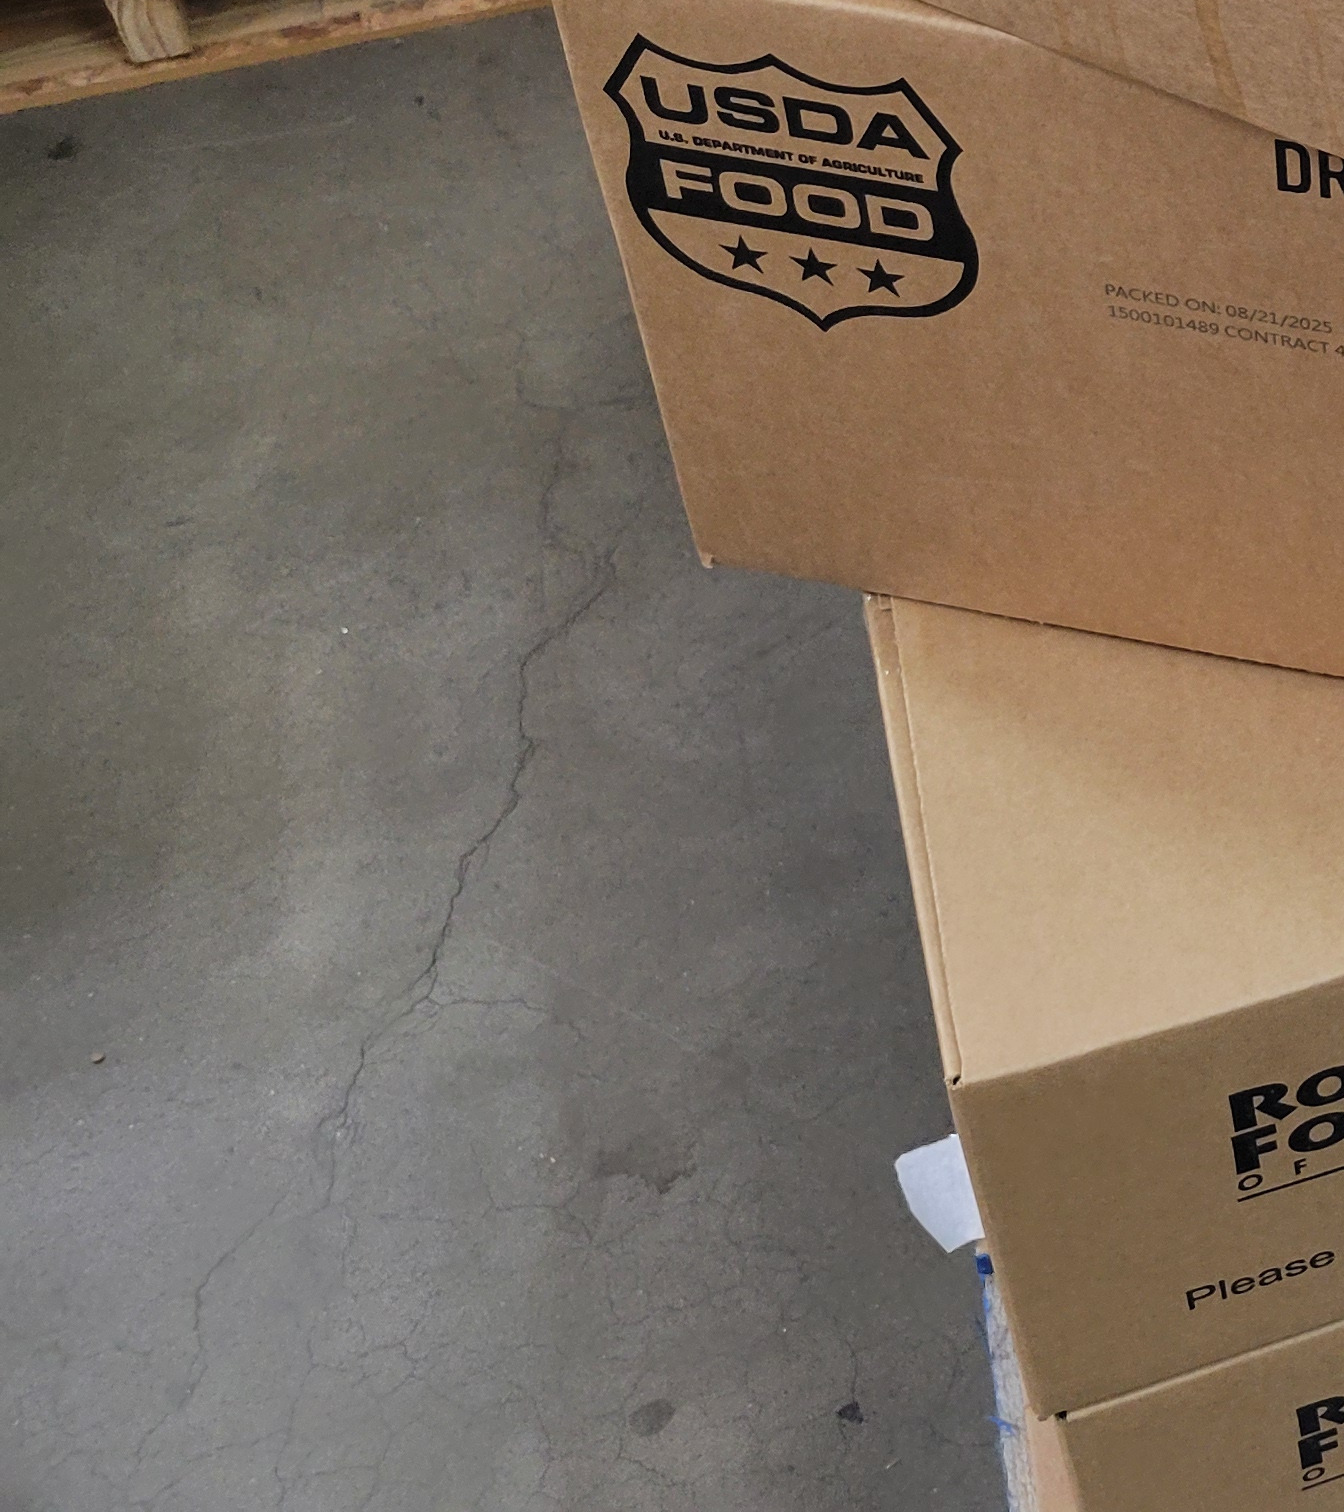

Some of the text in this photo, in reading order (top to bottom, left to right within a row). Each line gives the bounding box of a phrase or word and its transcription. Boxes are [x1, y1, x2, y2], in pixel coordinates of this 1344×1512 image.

[640, 75, 931, 159] USDA
[659, 130, 924, 183] U.S. DEPARTMENT OF AGRICULTURE
[658, 158, 934, 241] FOOD
[1104, 283, 1179, 308] PACKED
[1185, 298, 1221, 315] ON:
[1225, 304, 1333, 335] 08/21/2025
[1108, 305, 1220, 336] 1500101489
[1225, 325, 1329, 354] CONTRACT
[1186, 1250, 1335, 1310] Please
